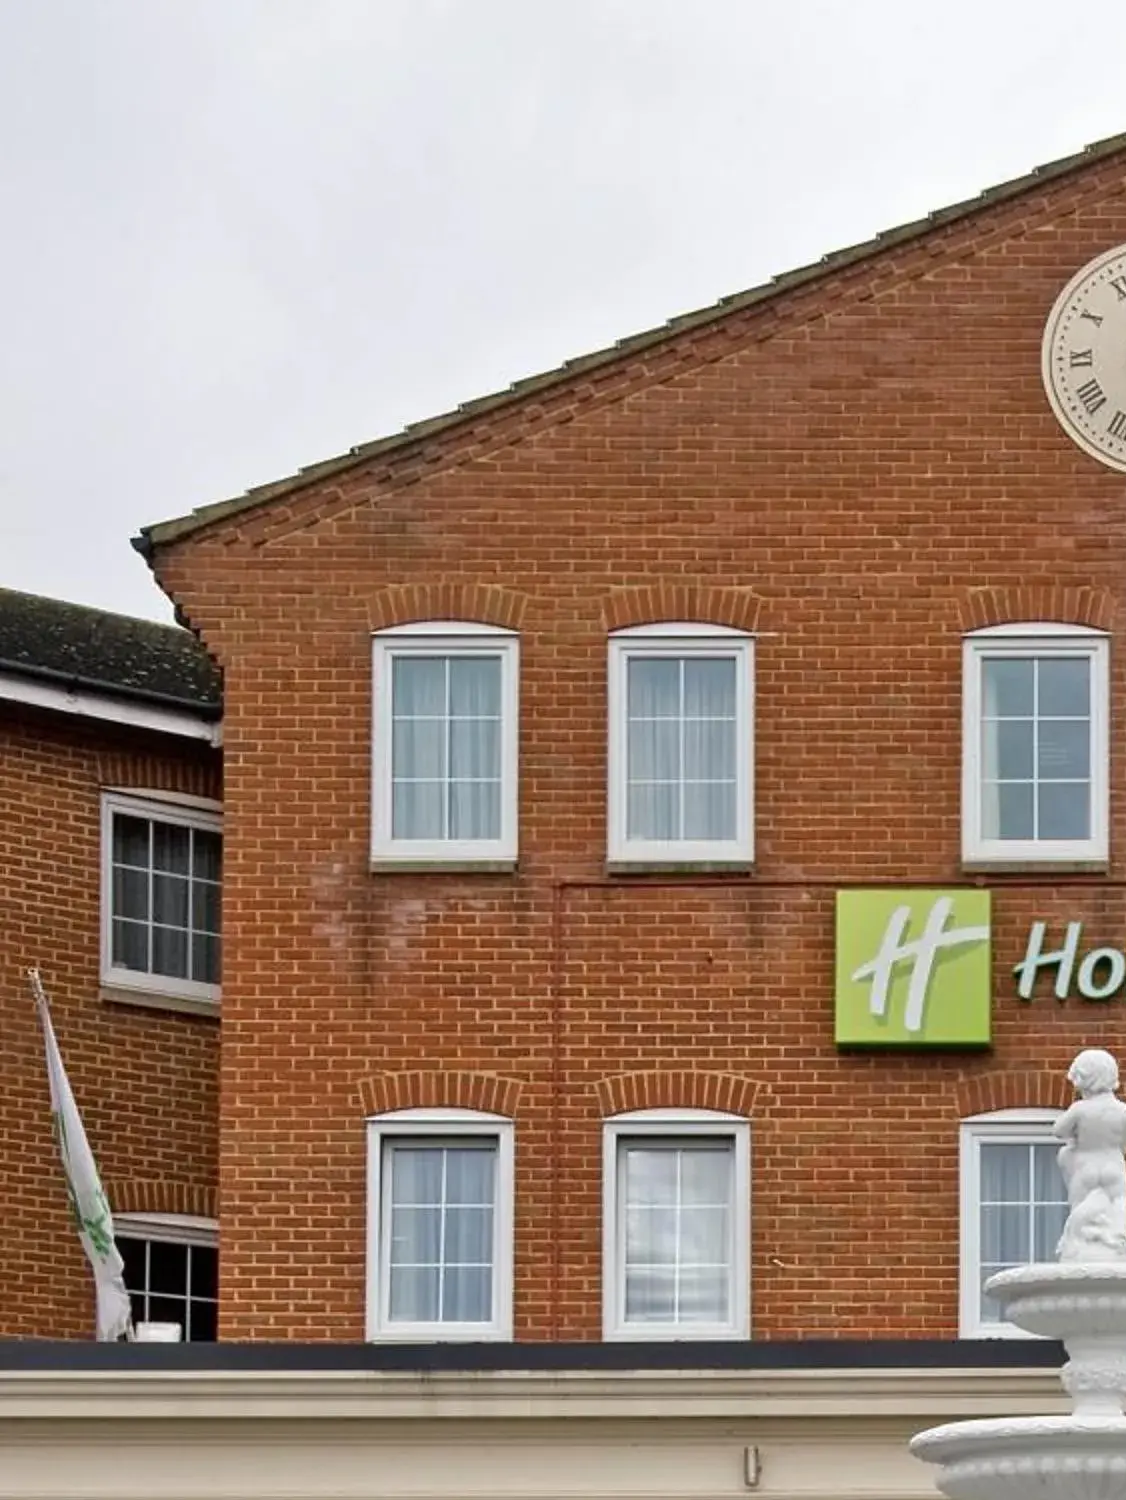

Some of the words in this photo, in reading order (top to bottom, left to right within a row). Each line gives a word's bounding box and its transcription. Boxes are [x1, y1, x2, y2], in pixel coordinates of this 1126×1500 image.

[1080, 309, 1103, 327] X
[1070, 349, 1092, 367] IX
[1076, 379, 1107, 415] VIII
[852, 897, 989, 1031] H
